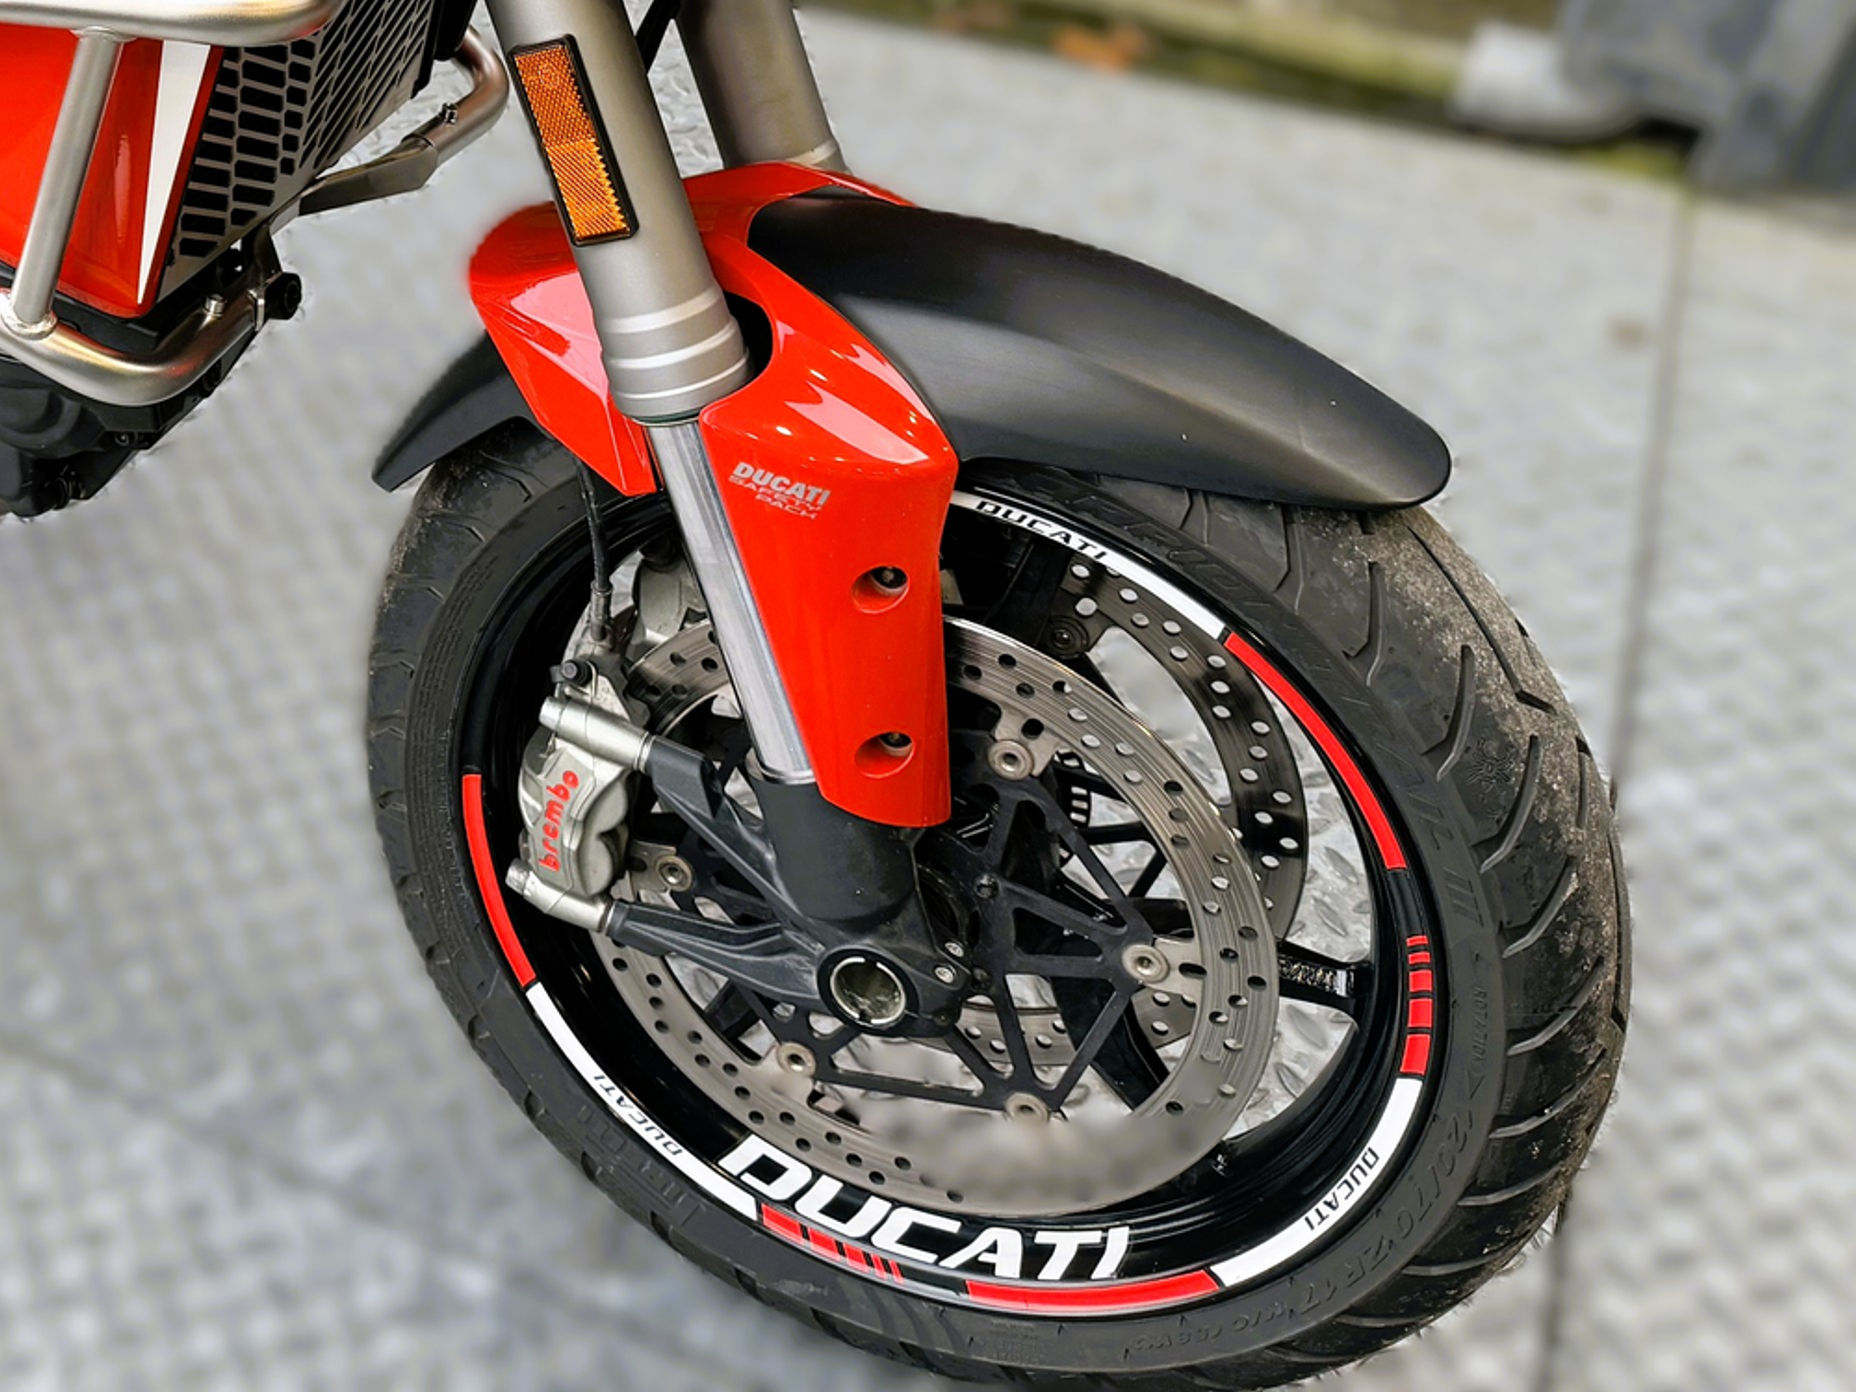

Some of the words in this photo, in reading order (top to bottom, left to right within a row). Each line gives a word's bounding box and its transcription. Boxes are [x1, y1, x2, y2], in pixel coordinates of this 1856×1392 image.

[732, 461, 831, 507] DUCATI
[975, 500, 1108, 560] DUCATI
[538, 770, 579, 872] brembo
[594, 1074, 684, 1156] DUCATI
[717, 1133, 1131, 1281] DUCATI
[1304, 1146, 1380, 1230] DUCATI
